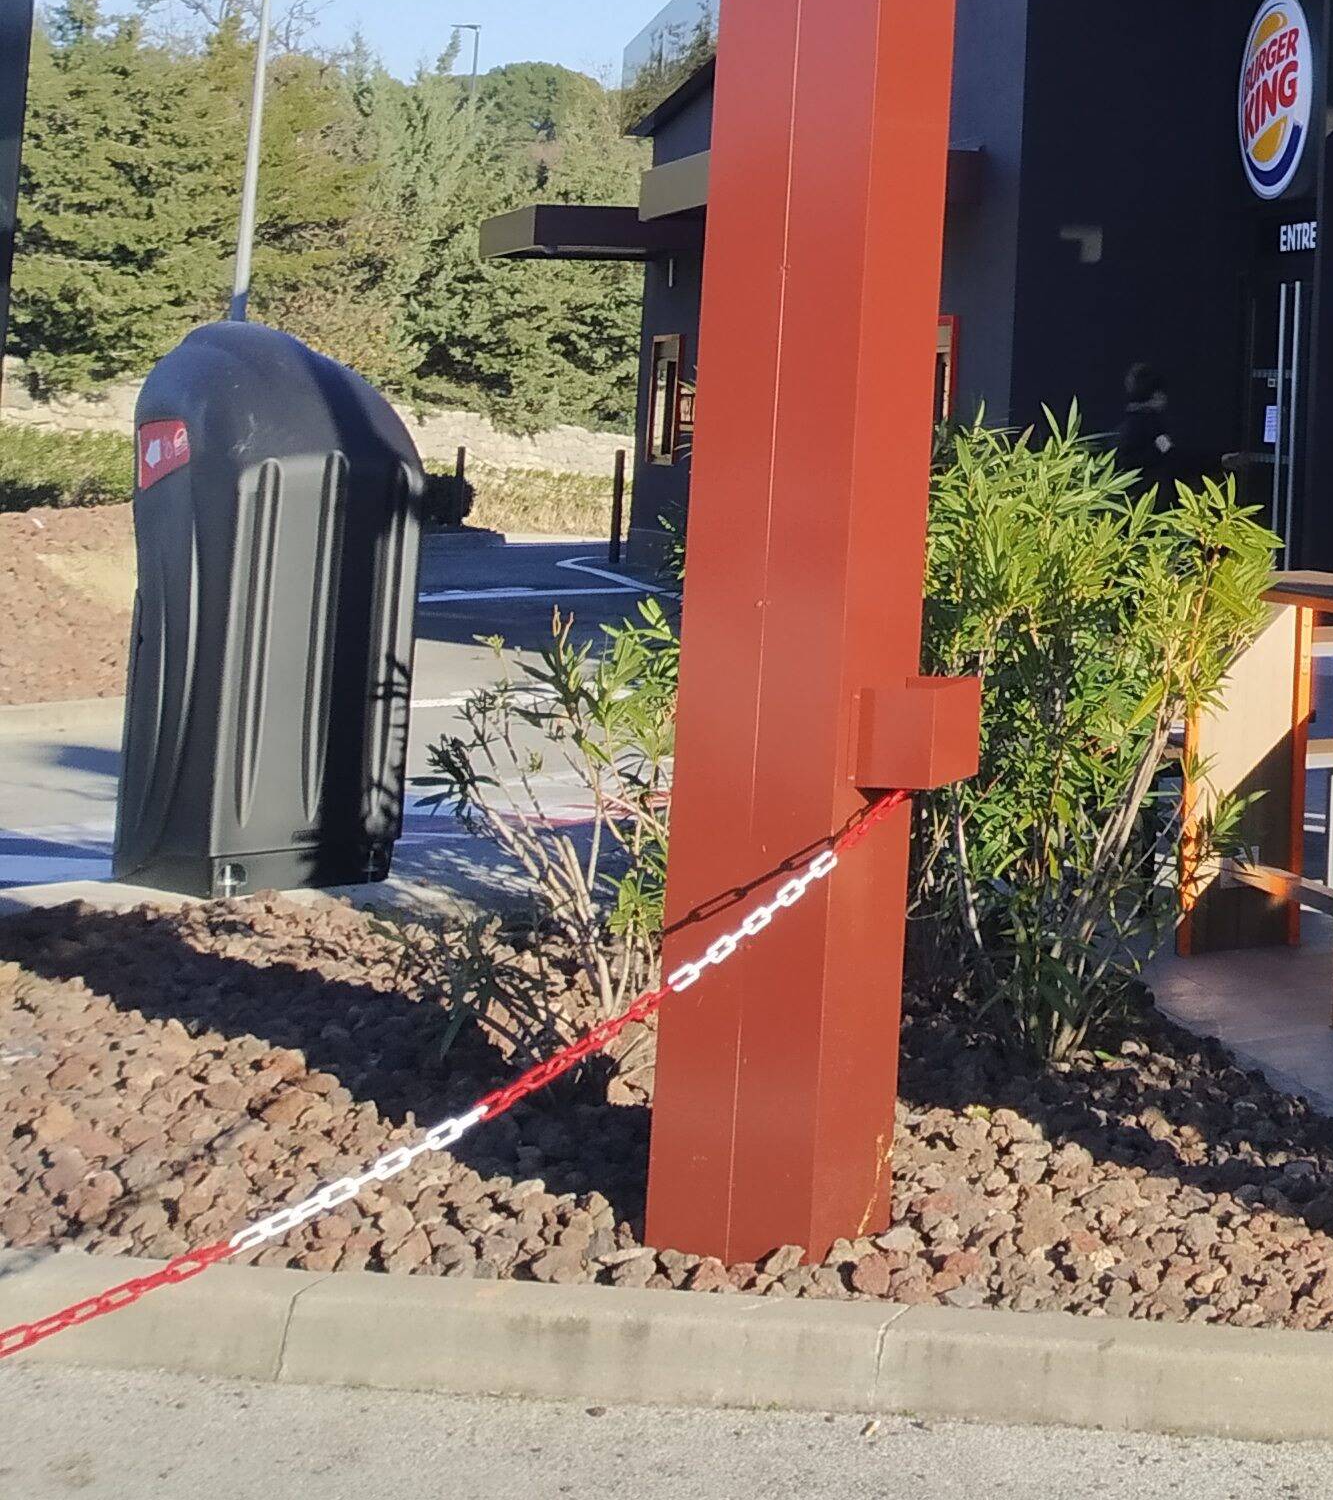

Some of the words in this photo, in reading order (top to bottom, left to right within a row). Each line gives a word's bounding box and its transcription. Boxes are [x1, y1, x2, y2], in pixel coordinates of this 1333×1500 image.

[1244, 27, 1299, 95] BURGER
[1243, 61, 1299, 143] KING
[1280, 221, 1317, 252] ENTRE
